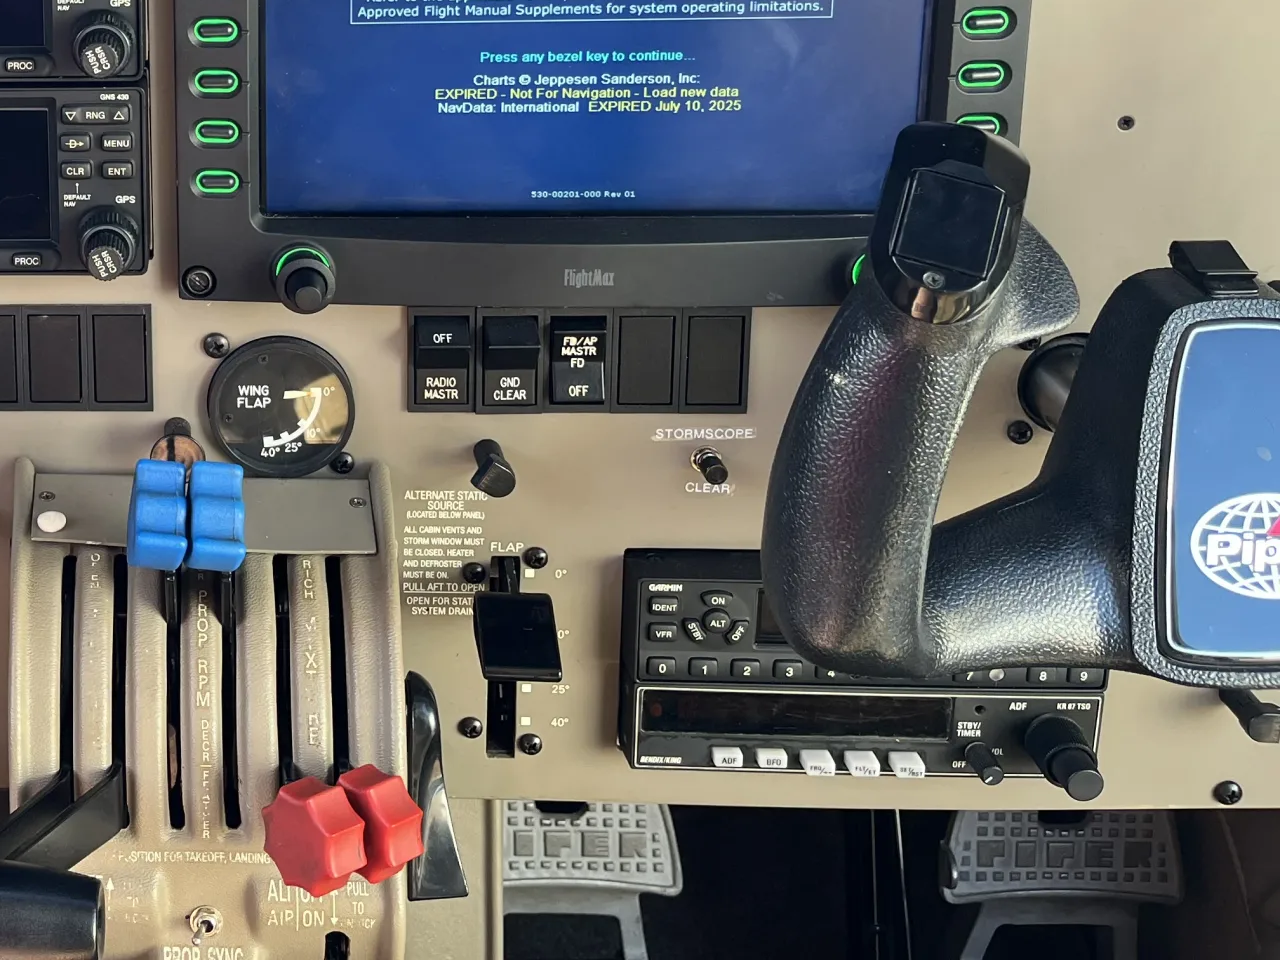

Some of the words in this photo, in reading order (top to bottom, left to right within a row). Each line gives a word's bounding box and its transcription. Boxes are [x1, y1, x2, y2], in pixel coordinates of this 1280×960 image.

[110, 0, 130, 7] GPS
[358, 6, 419, 19] Approved
[425, 5, 460, 18] Flight
[466, 5, 511, 15] Manual
[516, 4, 602, 17] Supplements
[607, 3, 625, 13] for
[630, 3, 677, 15] system
[682, 2, 745, 15] operating
[750, 1, 823, 11] limitations.
[481, 52, 517, 62] Press
[522, 54, 544, 64] any
[548, 51, 582, 62] bezel
[587, 51, 609, 63] key
[612, 51, 625, 61] to
[474, 75, 515, 85] Charts
[534, 75, 597, 88] Jeppesen
[435, 89, 497, 99] EXPIRED
[510, 89, 533, 99] Not
[536, 87, 559, 98] For
[562, 88, 630, 102] Navigation
[644, 87, 676, 98] Load
[681, 89, 706, 97] new
[710, 87, 738, 97] data
[438, 102, 496, 113] NavData:
[501, 102, 579, 112] International
[589, 100, 651, 112] EXPIRED
[656, 101, 680, 113] July
[709, 100, 741, 111] 2025
[564, 269, 614, 288] FlightMax
[433, 334, 452, 343] OFF
[571, 358, 584, 368] FD
[426, 377, 456, 389] RADIO
[500, 377, 520, 387] GND
[238, 385, 269, 397] WING
[425, 389, 458, 399] MASTR
[494, 390, 526, 400] CLEAR
[569, 385, 588, 396] OFF
[237, 396, 271, 408] FLAP
[654, 428, 755, 440] STORMSCOPE
[685, 482, 730, 494] CLEAR
[405, 491, 455, 502] ALTERNATE
[427, 500, 465, 512] SOURCE
[491, 542, 524, 552] FLAP
[653, 603, 677, 611] IDENT
[710, 618, 727, 627] ALT
